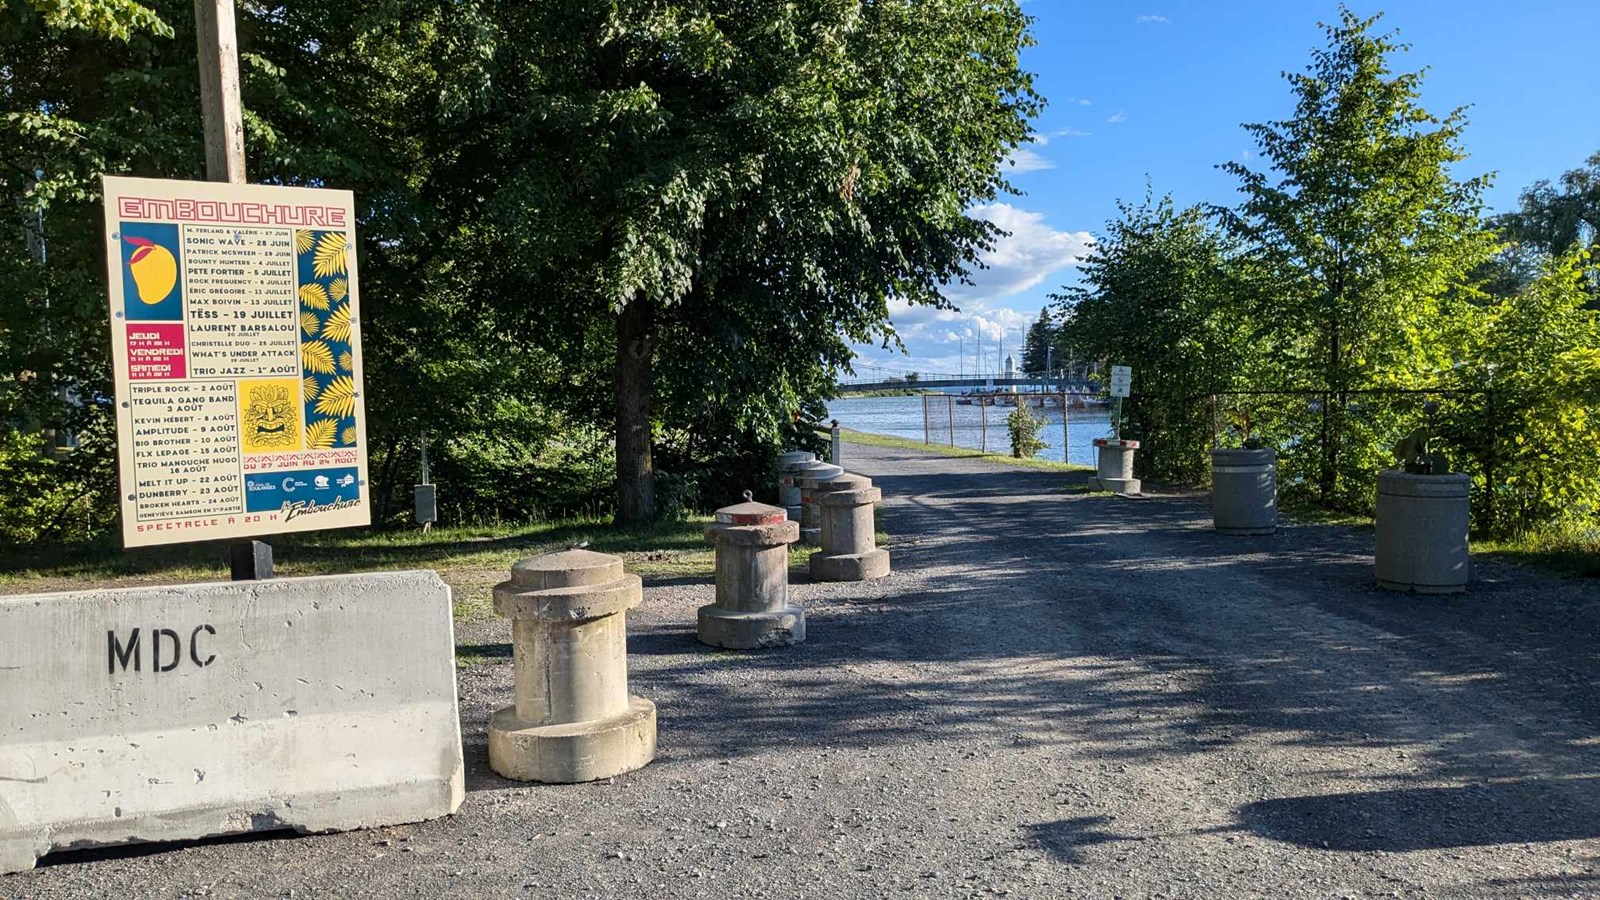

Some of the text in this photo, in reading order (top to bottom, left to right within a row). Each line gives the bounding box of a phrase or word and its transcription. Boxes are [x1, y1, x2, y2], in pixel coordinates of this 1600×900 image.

[118, 197, 346, 227] EMBOUCHURE
[218, 238, 246, 246] WAVE
[190, 308, 219, 319] TËSS
[233, 311, 246, 319] 19
[251, 311, 293, 319] JUILLET
[129, 332, 160, 340] JEUDI
[130, 348, 183, 356] VENDREDI
[270, 365, 296, 373] AOÛT
[176, 403, 203, 412] AOÛT
[135, 427, 189, 435] AMPLITUDE
[210, 424, 235, 432] AOÛT
[214, 435, 236, 443] AOÛT
[213, 445, 237, 453] AOÛT
[161, 459, 210, 467] MANOUCHE
[183, 465, 207, 473] AOÛT
[213, 473, 238, 482] AOÛT
[139, 489, 188, 499] DUNBERRY
[214, 484, 239, 493] AOÛT
[220, 495, 239, 503] AOÛT
[136, 518, 218, 533] SPECTACLE
[244, 515, 261, 523] 20
[107, 624, 216, 674] MDC
